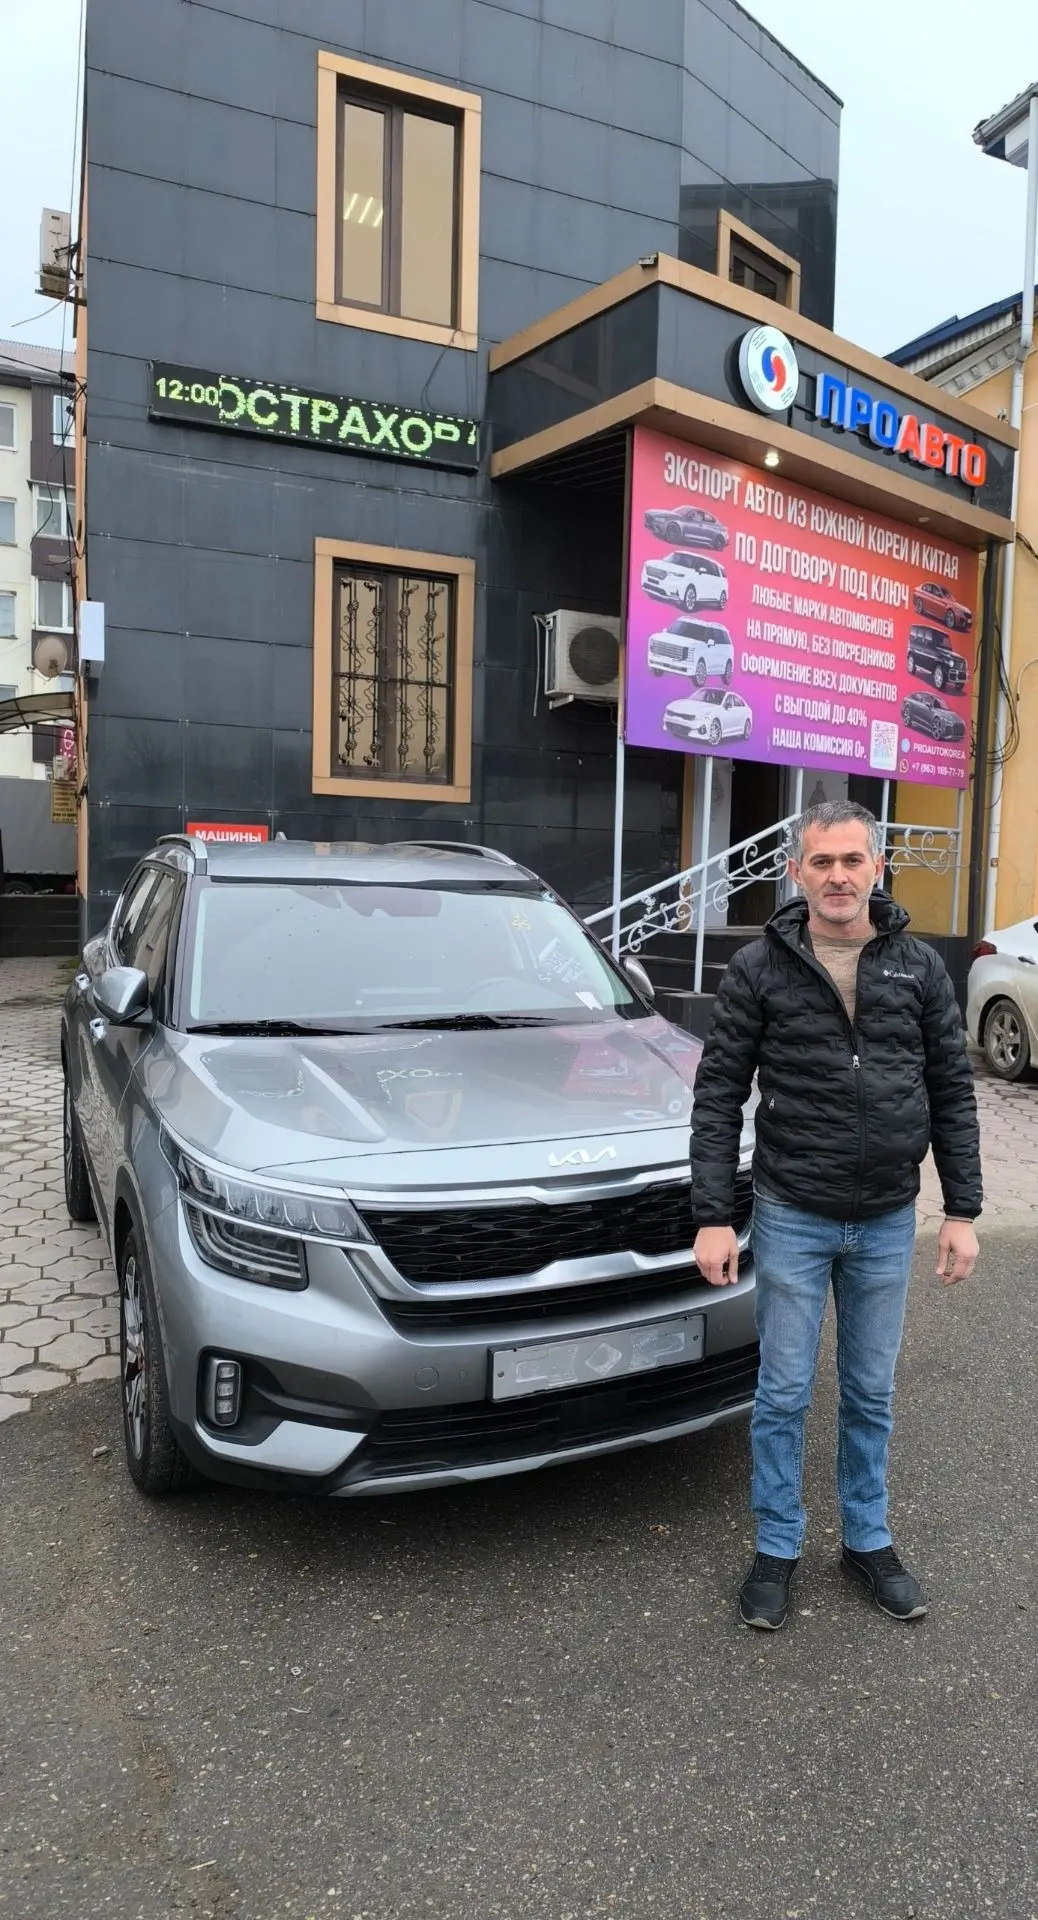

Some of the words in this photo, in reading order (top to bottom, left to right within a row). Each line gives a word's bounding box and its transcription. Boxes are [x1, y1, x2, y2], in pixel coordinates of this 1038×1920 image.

[155, 377, 219, 407] 12:00
[815, 373, 987, 487] ПРОАВТО
[664, 452, 741, 505] ЭКСПОРТ
[744, 481, 783, 520] АВТО
[787, 496, 806, 528] ИЗ
[811, 504, 865, 548] ЮЖНОЙ
[868, 525, 908, 562] КОРЕИ
[911, 540, 919, 566] И
[922, 544, 959, 580] КИТАЯ
[735, 532, 757, 565] ПО
[760, 540, 837, 587] ДОГОВОРУ
[840, 565, 868, 600] ПОД
[871, 574, 909, 609] КЛЮЧ
[752, 584, 792, 612] ЛЮБЫЕ
[794, 596, 827, 622] МАРКИ
[829, 609, 894, 639] АВТОМОБИЛЕЙ
[747, 618, 761, 639] НА
[763, 622, 810, 652] ПРЯМУЮ,
[812, 635, 830, 655] БЕЗ
[832, 639, 895, 670] ПОСРЕДНИКОВ
[741, 653, 811, 684] ОФОРМЛЕНИЕ
[813, 667, 837, 689] ВСЕХ
[839, 673, 897, 701] ДОКУМЕНТОВ
[775, 694, 784, 712] С
[784, 695, 830, 720] ВЫГОДОЙ
[832, 704, 846, 724] ДО
[847, 706, 867, 727] 40%
[773, 727, 802, 750] НАША
[803, 732, 853, 755] КОМИССИЯ
[913, 742, 966, 760] PROAUTOKOREA
[195, 830, 262, 842] МАШИНЫ
